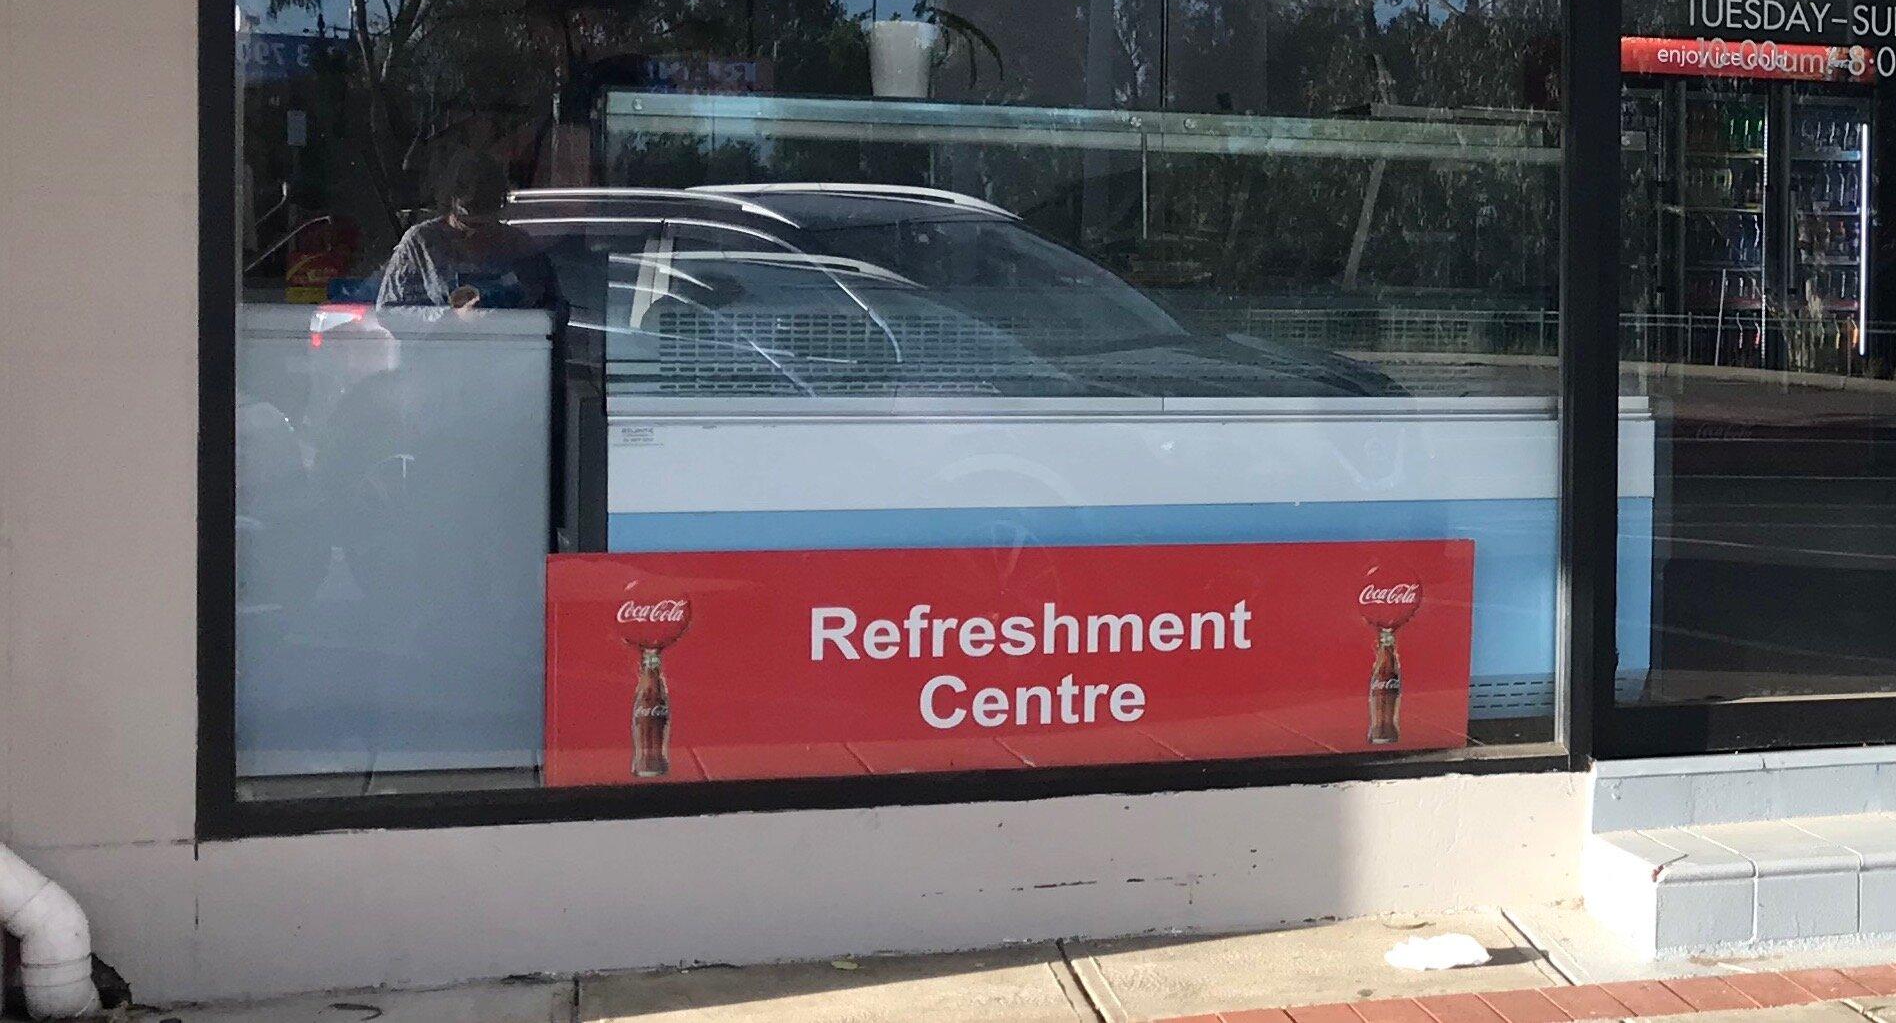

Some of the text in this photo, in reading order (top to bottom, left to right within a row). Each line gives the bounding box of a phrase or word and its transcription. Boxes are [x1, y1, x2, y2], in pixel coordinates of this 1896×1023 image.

[1657, 45, 1709, 68] enjoy
[808, 599, 1253, 663] Refreshment
[918, 672, 1146, 730] Centre
